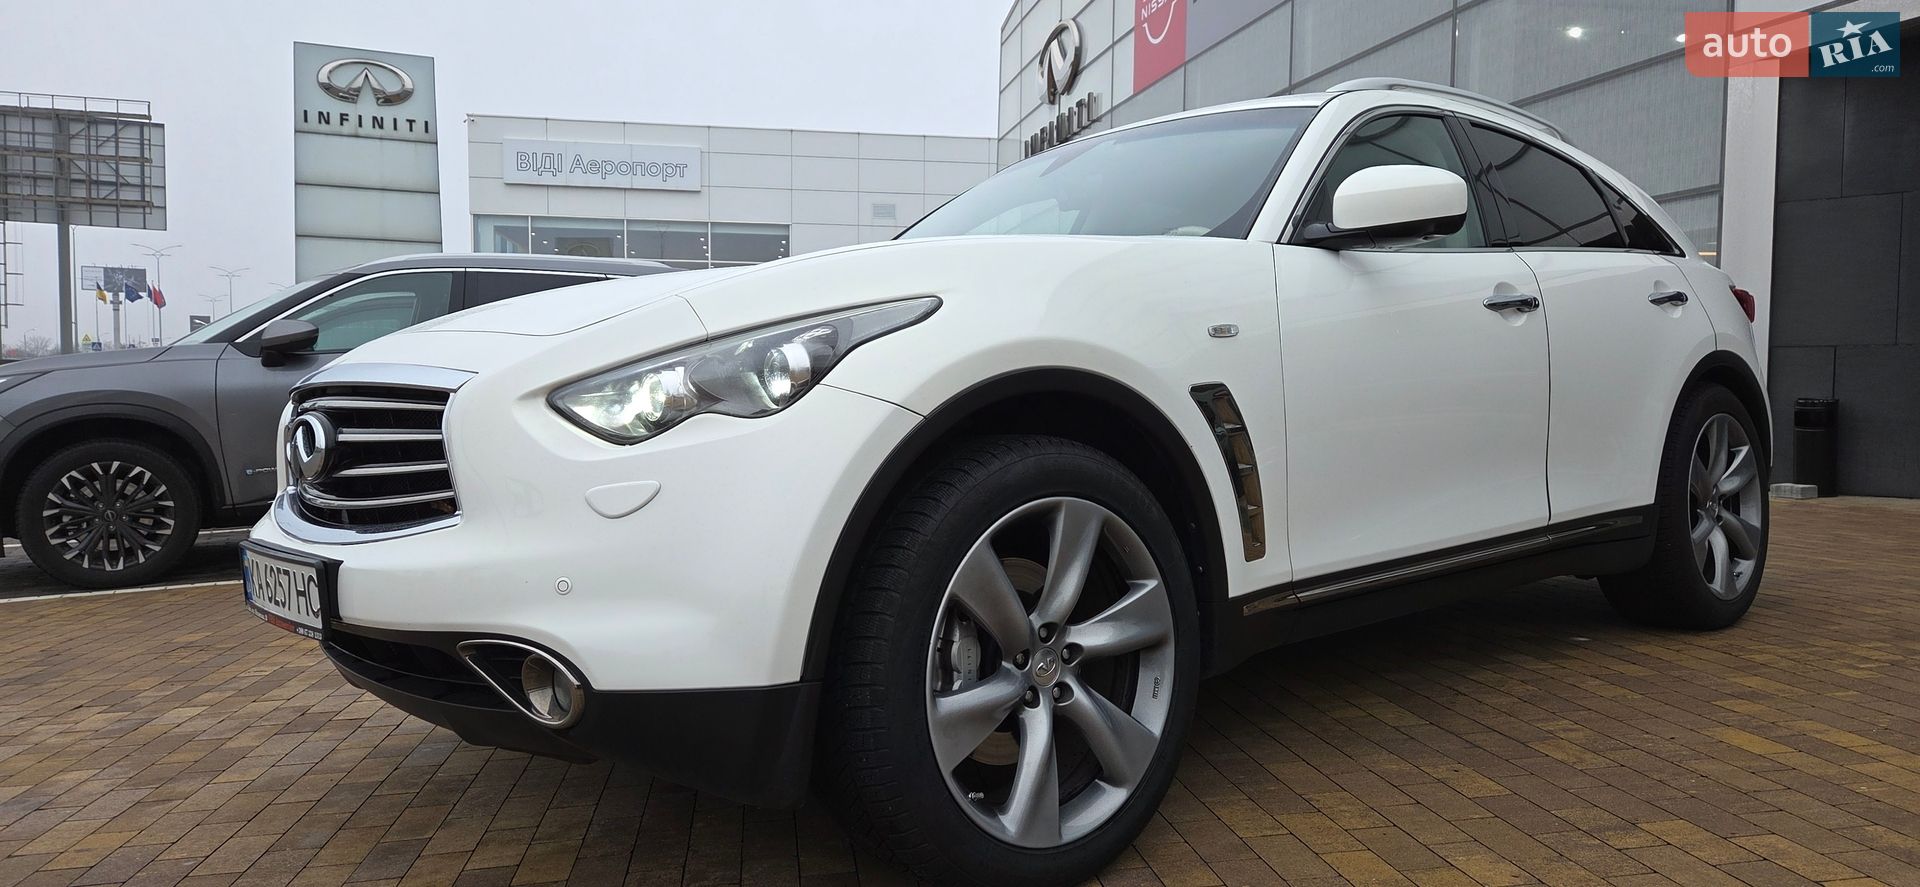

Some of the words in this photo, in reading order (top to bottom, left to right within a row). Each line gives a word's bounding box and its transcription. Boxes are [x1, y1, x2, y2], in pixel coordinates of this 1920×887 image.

[303, 109, 429, 134] INFINITI
[516, 151, 562, 177] ВІДІ
[569, 154, 687, 182] Аеропорт
[264, 562, 291, 612] 6257
[293, 570, 321, 618] HC
